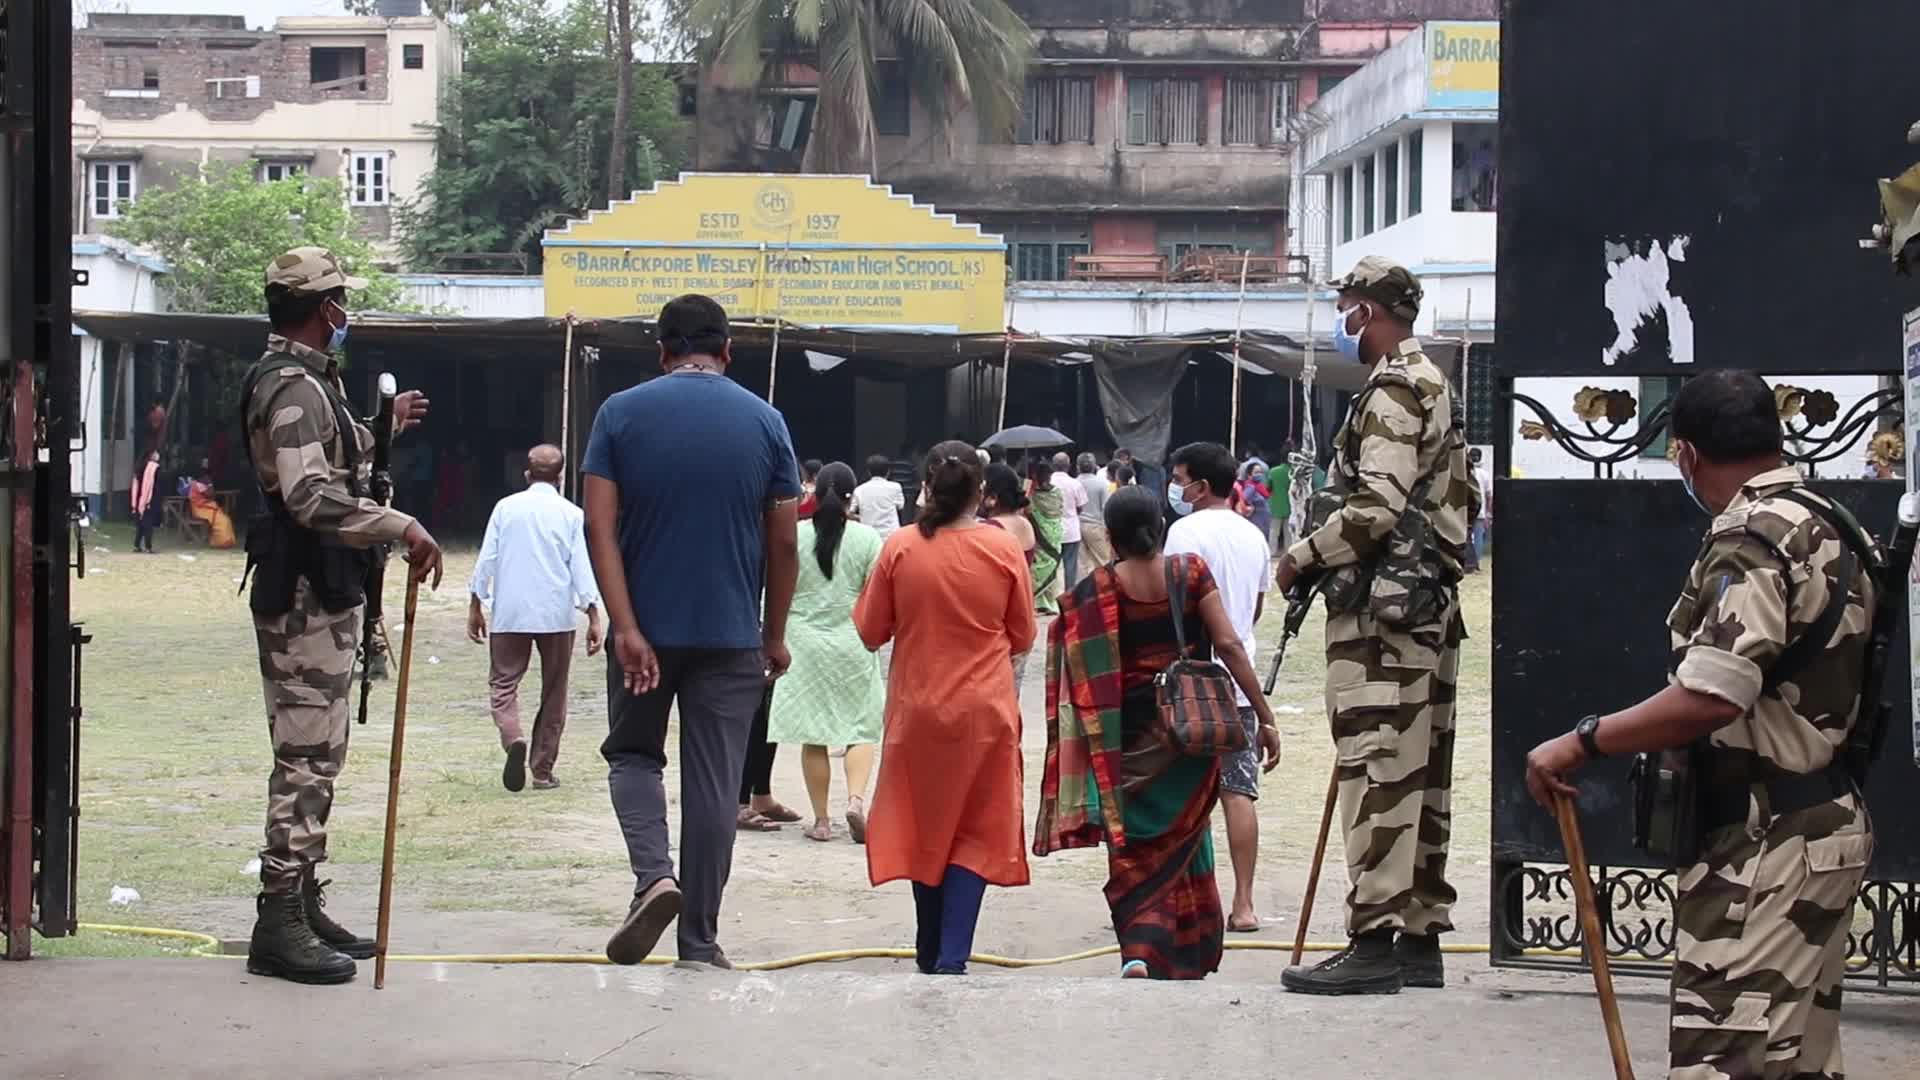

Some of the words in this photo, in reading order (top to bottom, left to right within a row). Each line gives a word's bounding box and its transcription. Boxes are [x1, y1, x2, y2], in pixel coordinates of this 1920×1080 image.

[700, 213, 739, 229] ESTD
[577, 251, 692, 273] BARRACKPORE
[696, 253, 757, 273] WESLEY
[857, 255, 892, 275] HIGH
[896, 255, 960, 276] SCHOOL
[652, 277, 678, 289] WEST
[782, 295, 840, 306] SECONDARY
[846, 295, 902, 307] EDUCATION
